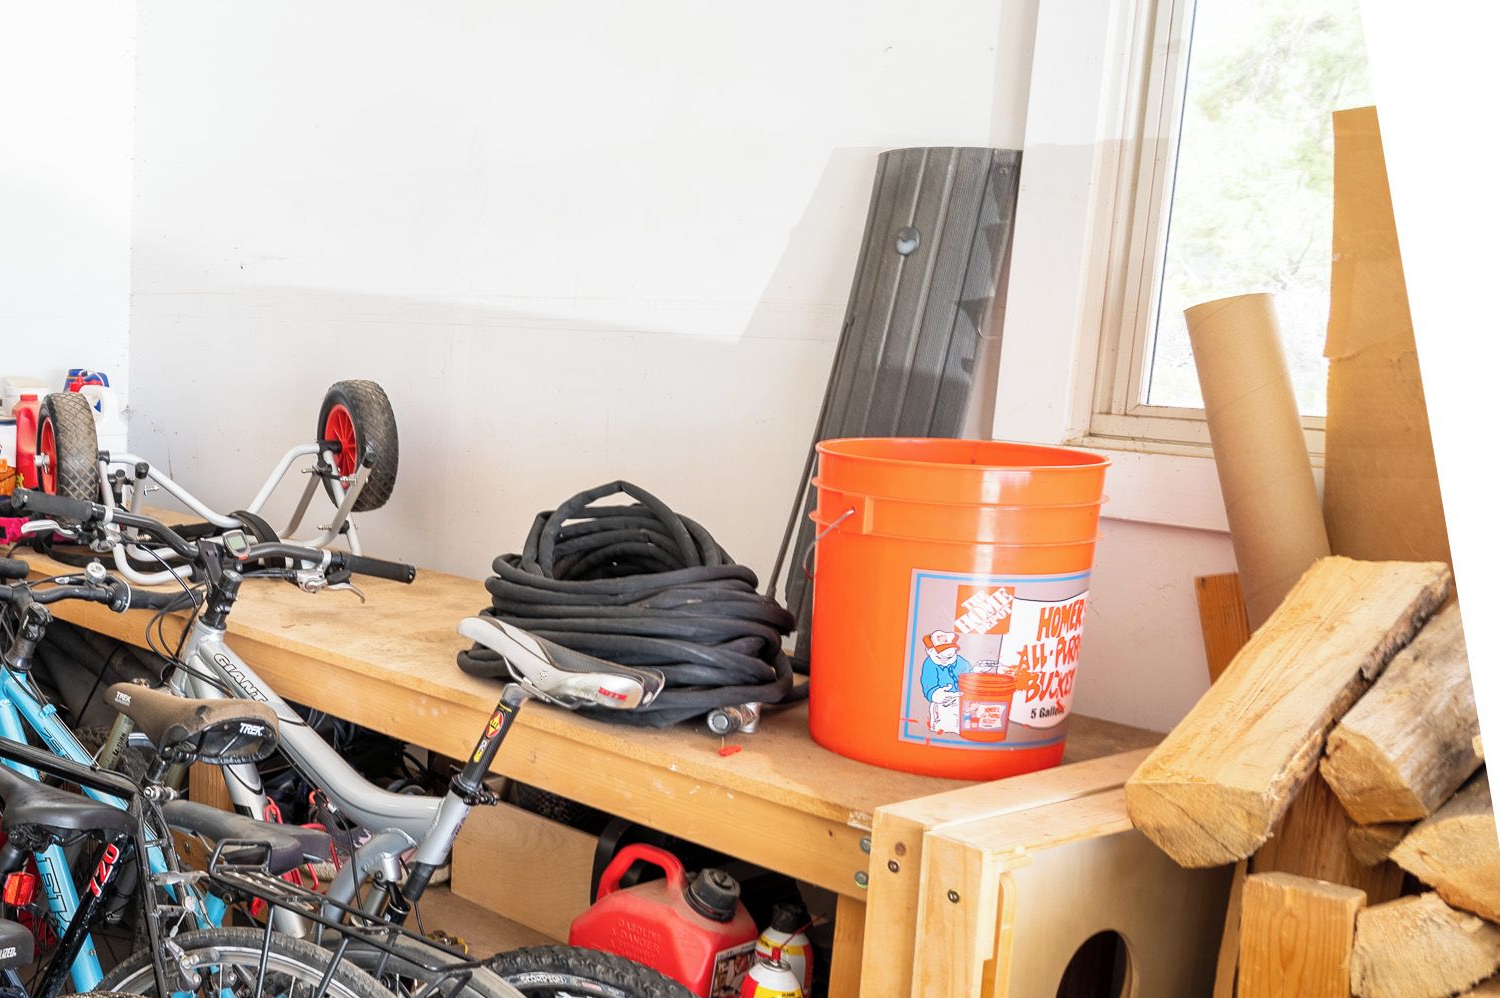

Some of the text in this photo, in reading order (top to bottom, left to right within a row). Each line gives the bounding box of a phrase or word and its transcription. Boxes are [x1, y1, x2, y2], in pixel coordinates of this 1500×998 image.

[954, 587, 1013, 634] HOME
[213, 652, 269, 703] GIANT
[115, 691, 132, 704] TREK
[1030, 708, 1038, 719] 5
[238, 722, 264, 737] TREK
